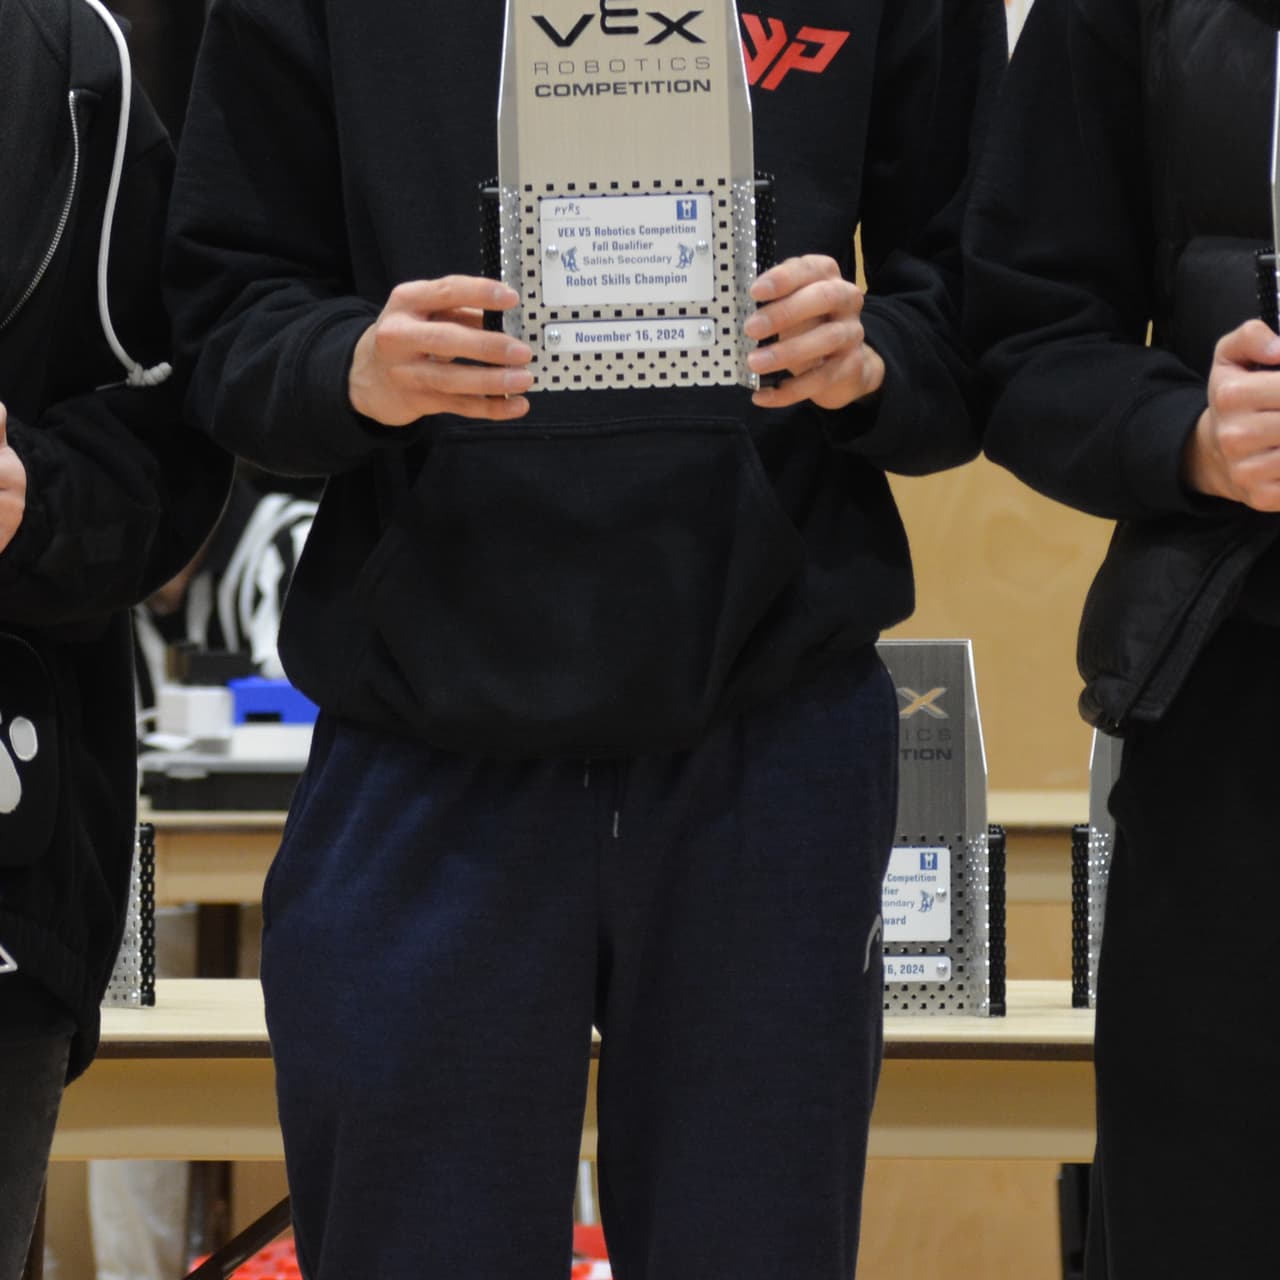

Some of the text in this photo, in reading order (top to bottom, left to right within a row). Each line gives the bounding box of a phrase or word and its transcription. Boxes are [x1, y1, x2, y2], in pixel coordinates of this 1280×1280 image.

[533, 56, 711, 76] ROBOTICS
[534, 78, 711, 98] COMPETITION
[558, 224, 696, 237] VEX V5 Robotics Competition
[592, 240, 654, 252] Fall Qualifier
[583, 255, 673, 266] Salish Secondary
[566, 272, 688, 287] Robot Skills Champion
[575, 328, 685, 343] November 16, 2024
[887, 873, 937, 883] Competition
[882, 899, 915, 909] ondary
[900, 964, 925, 974] 2024
